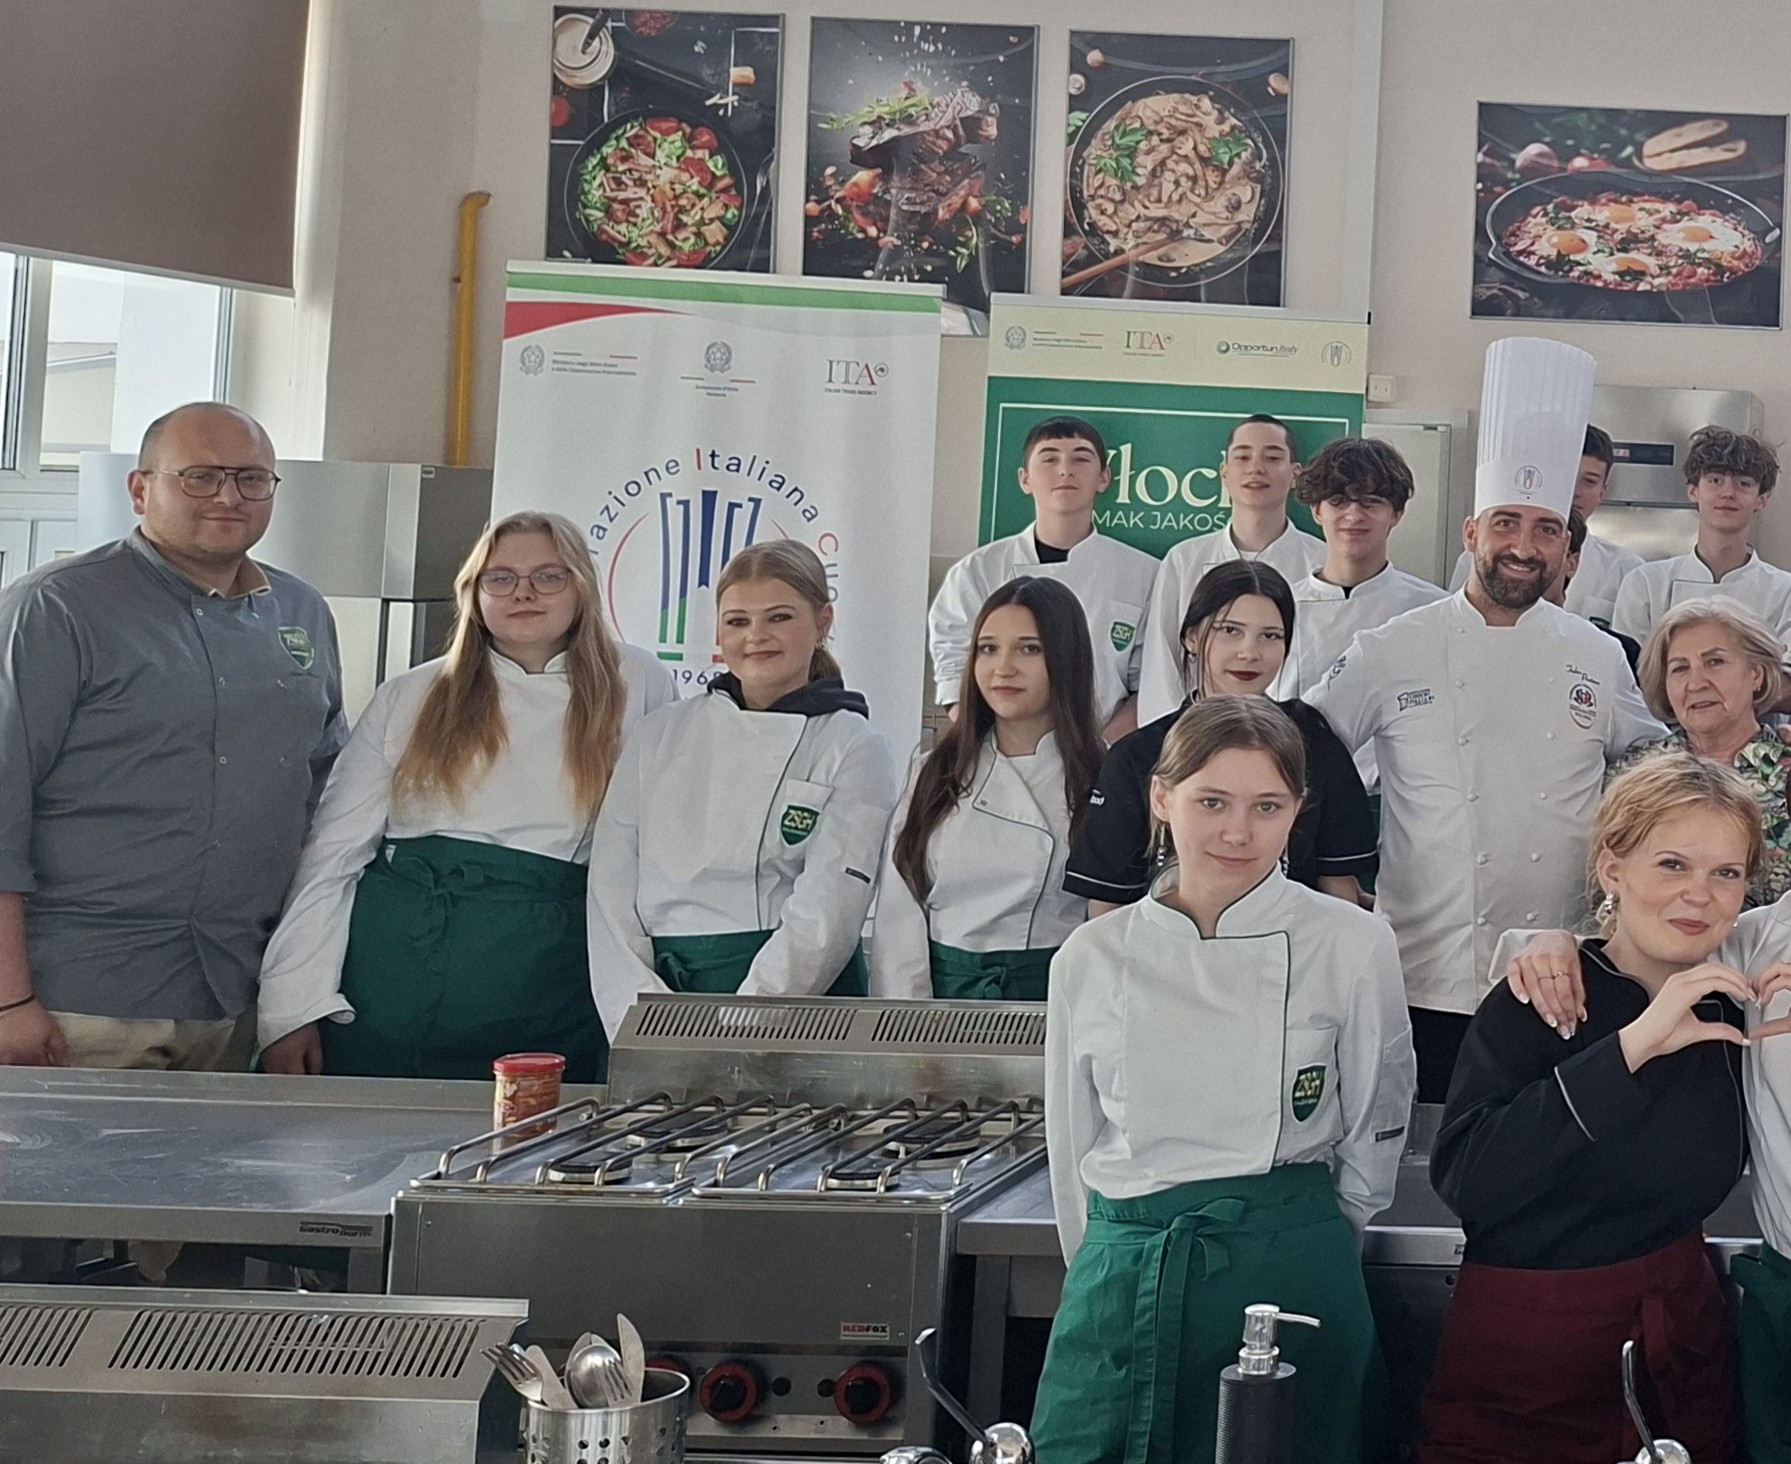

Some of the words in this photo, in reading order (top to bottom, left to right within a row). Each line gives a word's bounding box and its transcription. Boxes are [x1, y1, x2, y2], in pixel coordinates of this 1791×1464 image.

[1125, 330, 1165, 350] ITA
[826, 359, 877, 386] ITA
[1106, 443, 1232, 508] łoc
[589, 459, 681, 549] azione
[696, 448, 819, 523] Italiana
[1092, 509, 1145, 529] MAK
[1150, 510, 1226, 531] JAKOŚ
